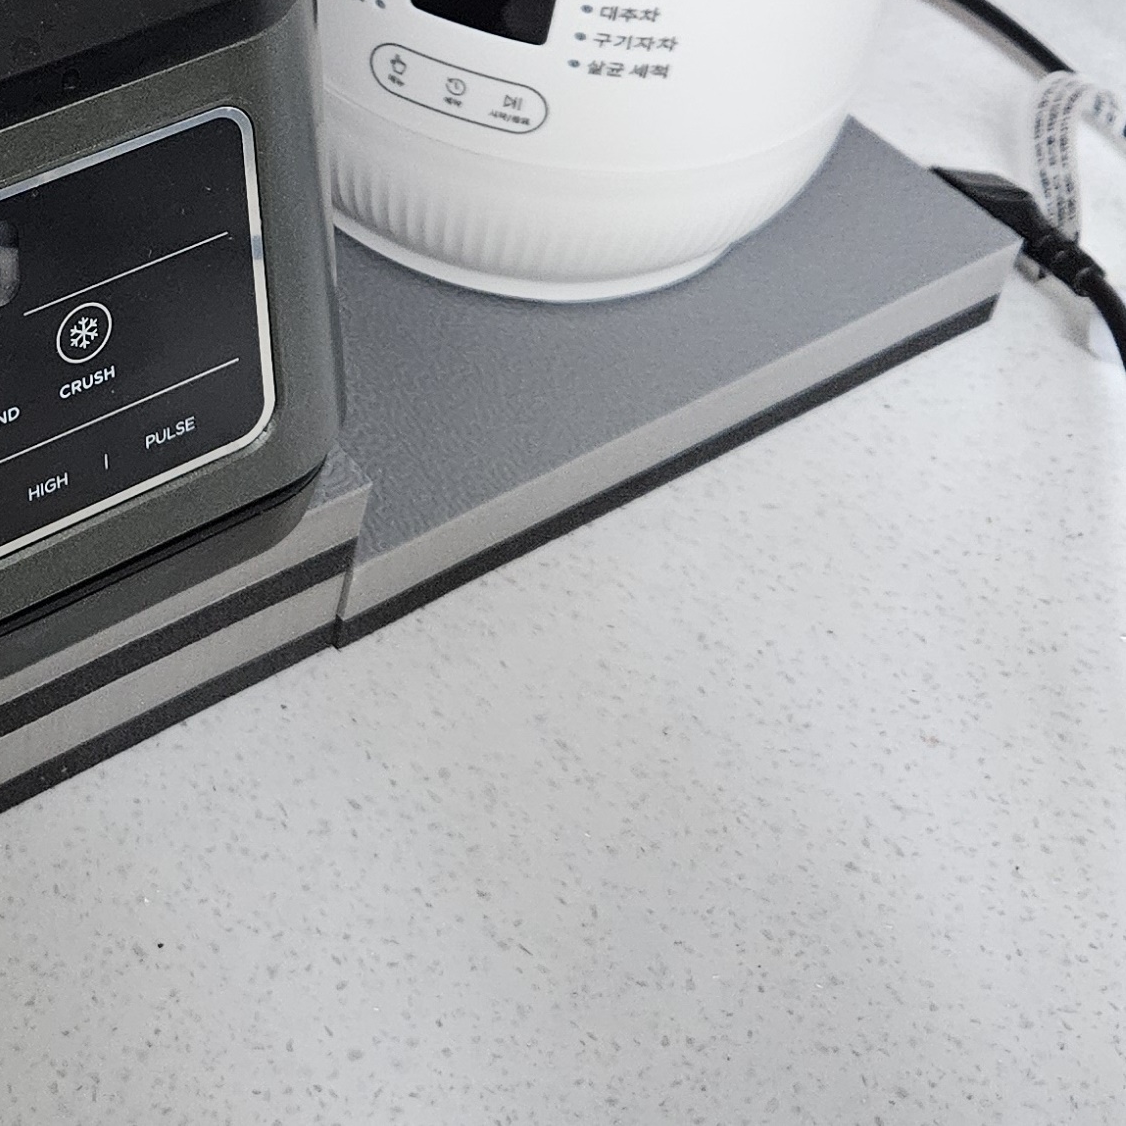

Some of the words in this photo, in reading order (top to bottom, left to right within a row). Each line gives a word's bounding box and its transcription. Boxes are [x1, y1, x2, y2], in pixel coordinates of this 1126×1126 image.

[600, 5, 661, 23] 대추차
[59, 365, 116, 399] CRUSH
[27, 473, 69, 501] HIGH
[144, 415, 196, 450] PULSE
